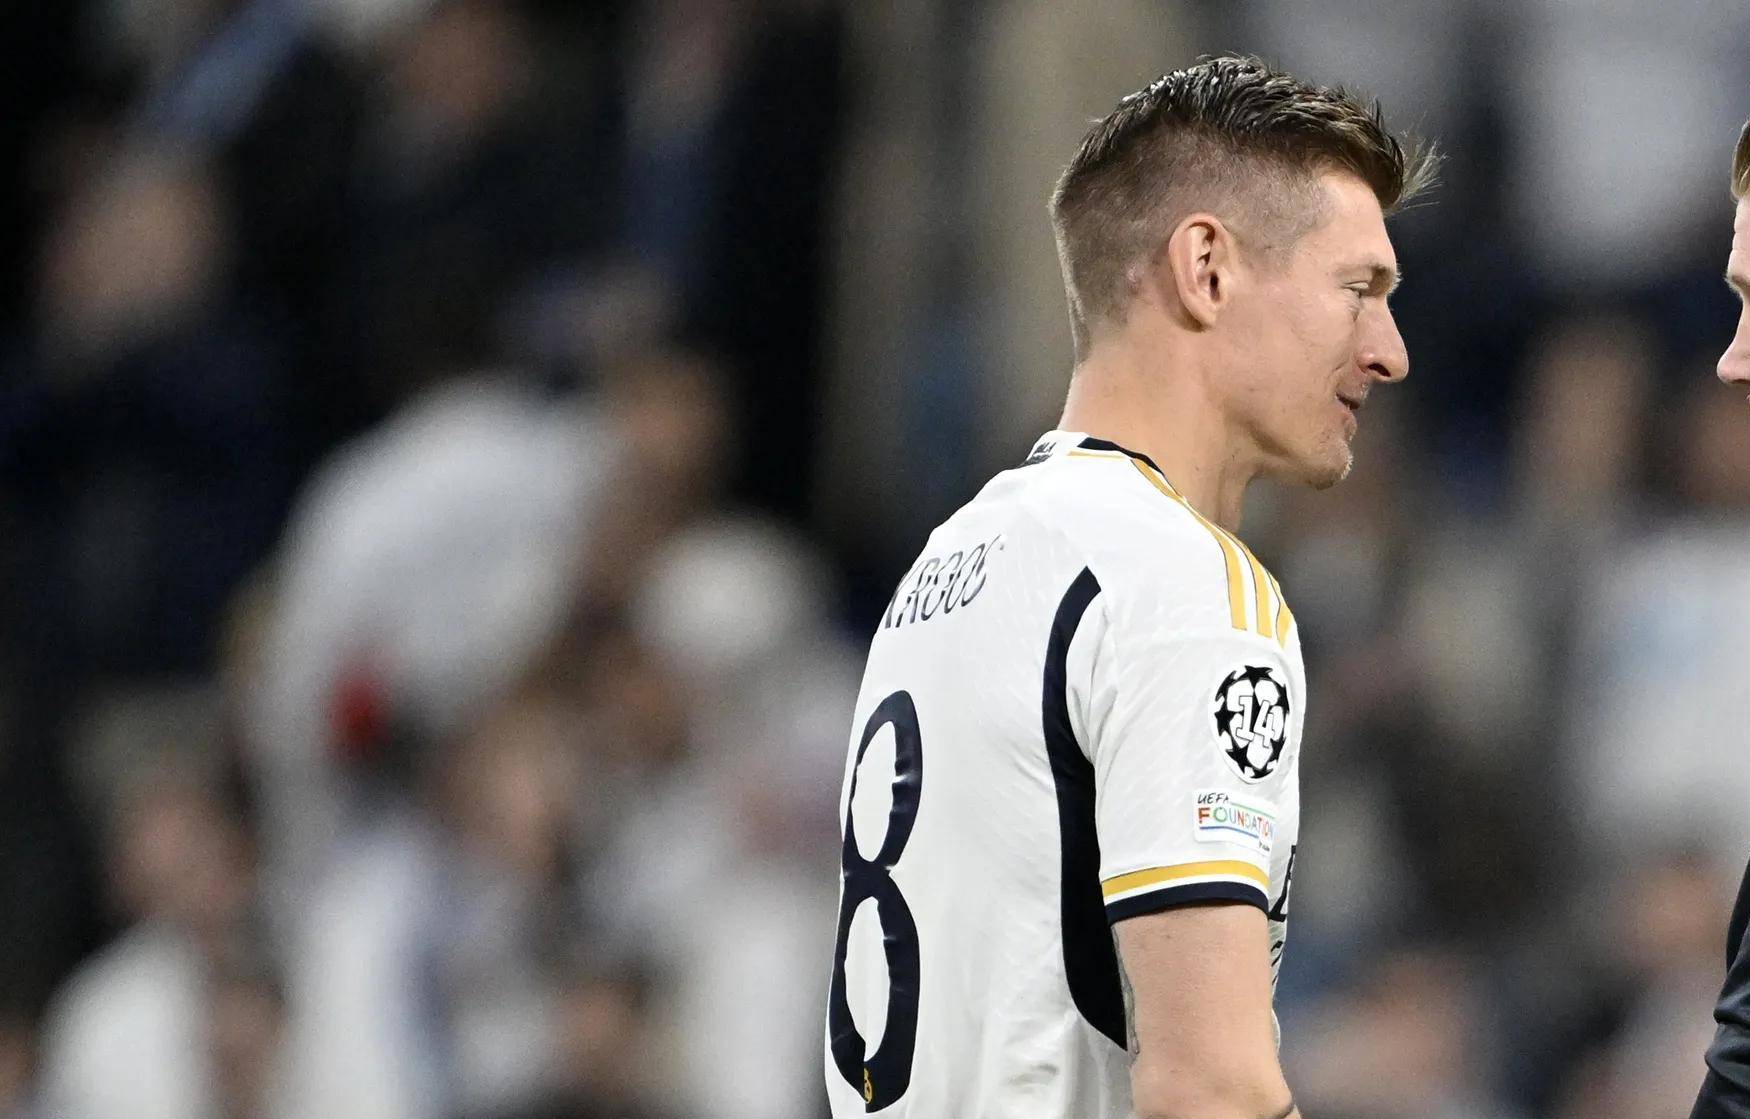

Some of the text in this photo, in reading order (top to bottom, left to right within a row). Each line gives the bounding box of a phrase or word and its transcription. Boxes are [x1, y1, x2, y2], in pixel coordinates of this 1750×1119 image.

[1236, 695, 1275, 748] 14
[1198, 792, 1229, 804] UEFA
[829, 689, 922, 1113] 8
